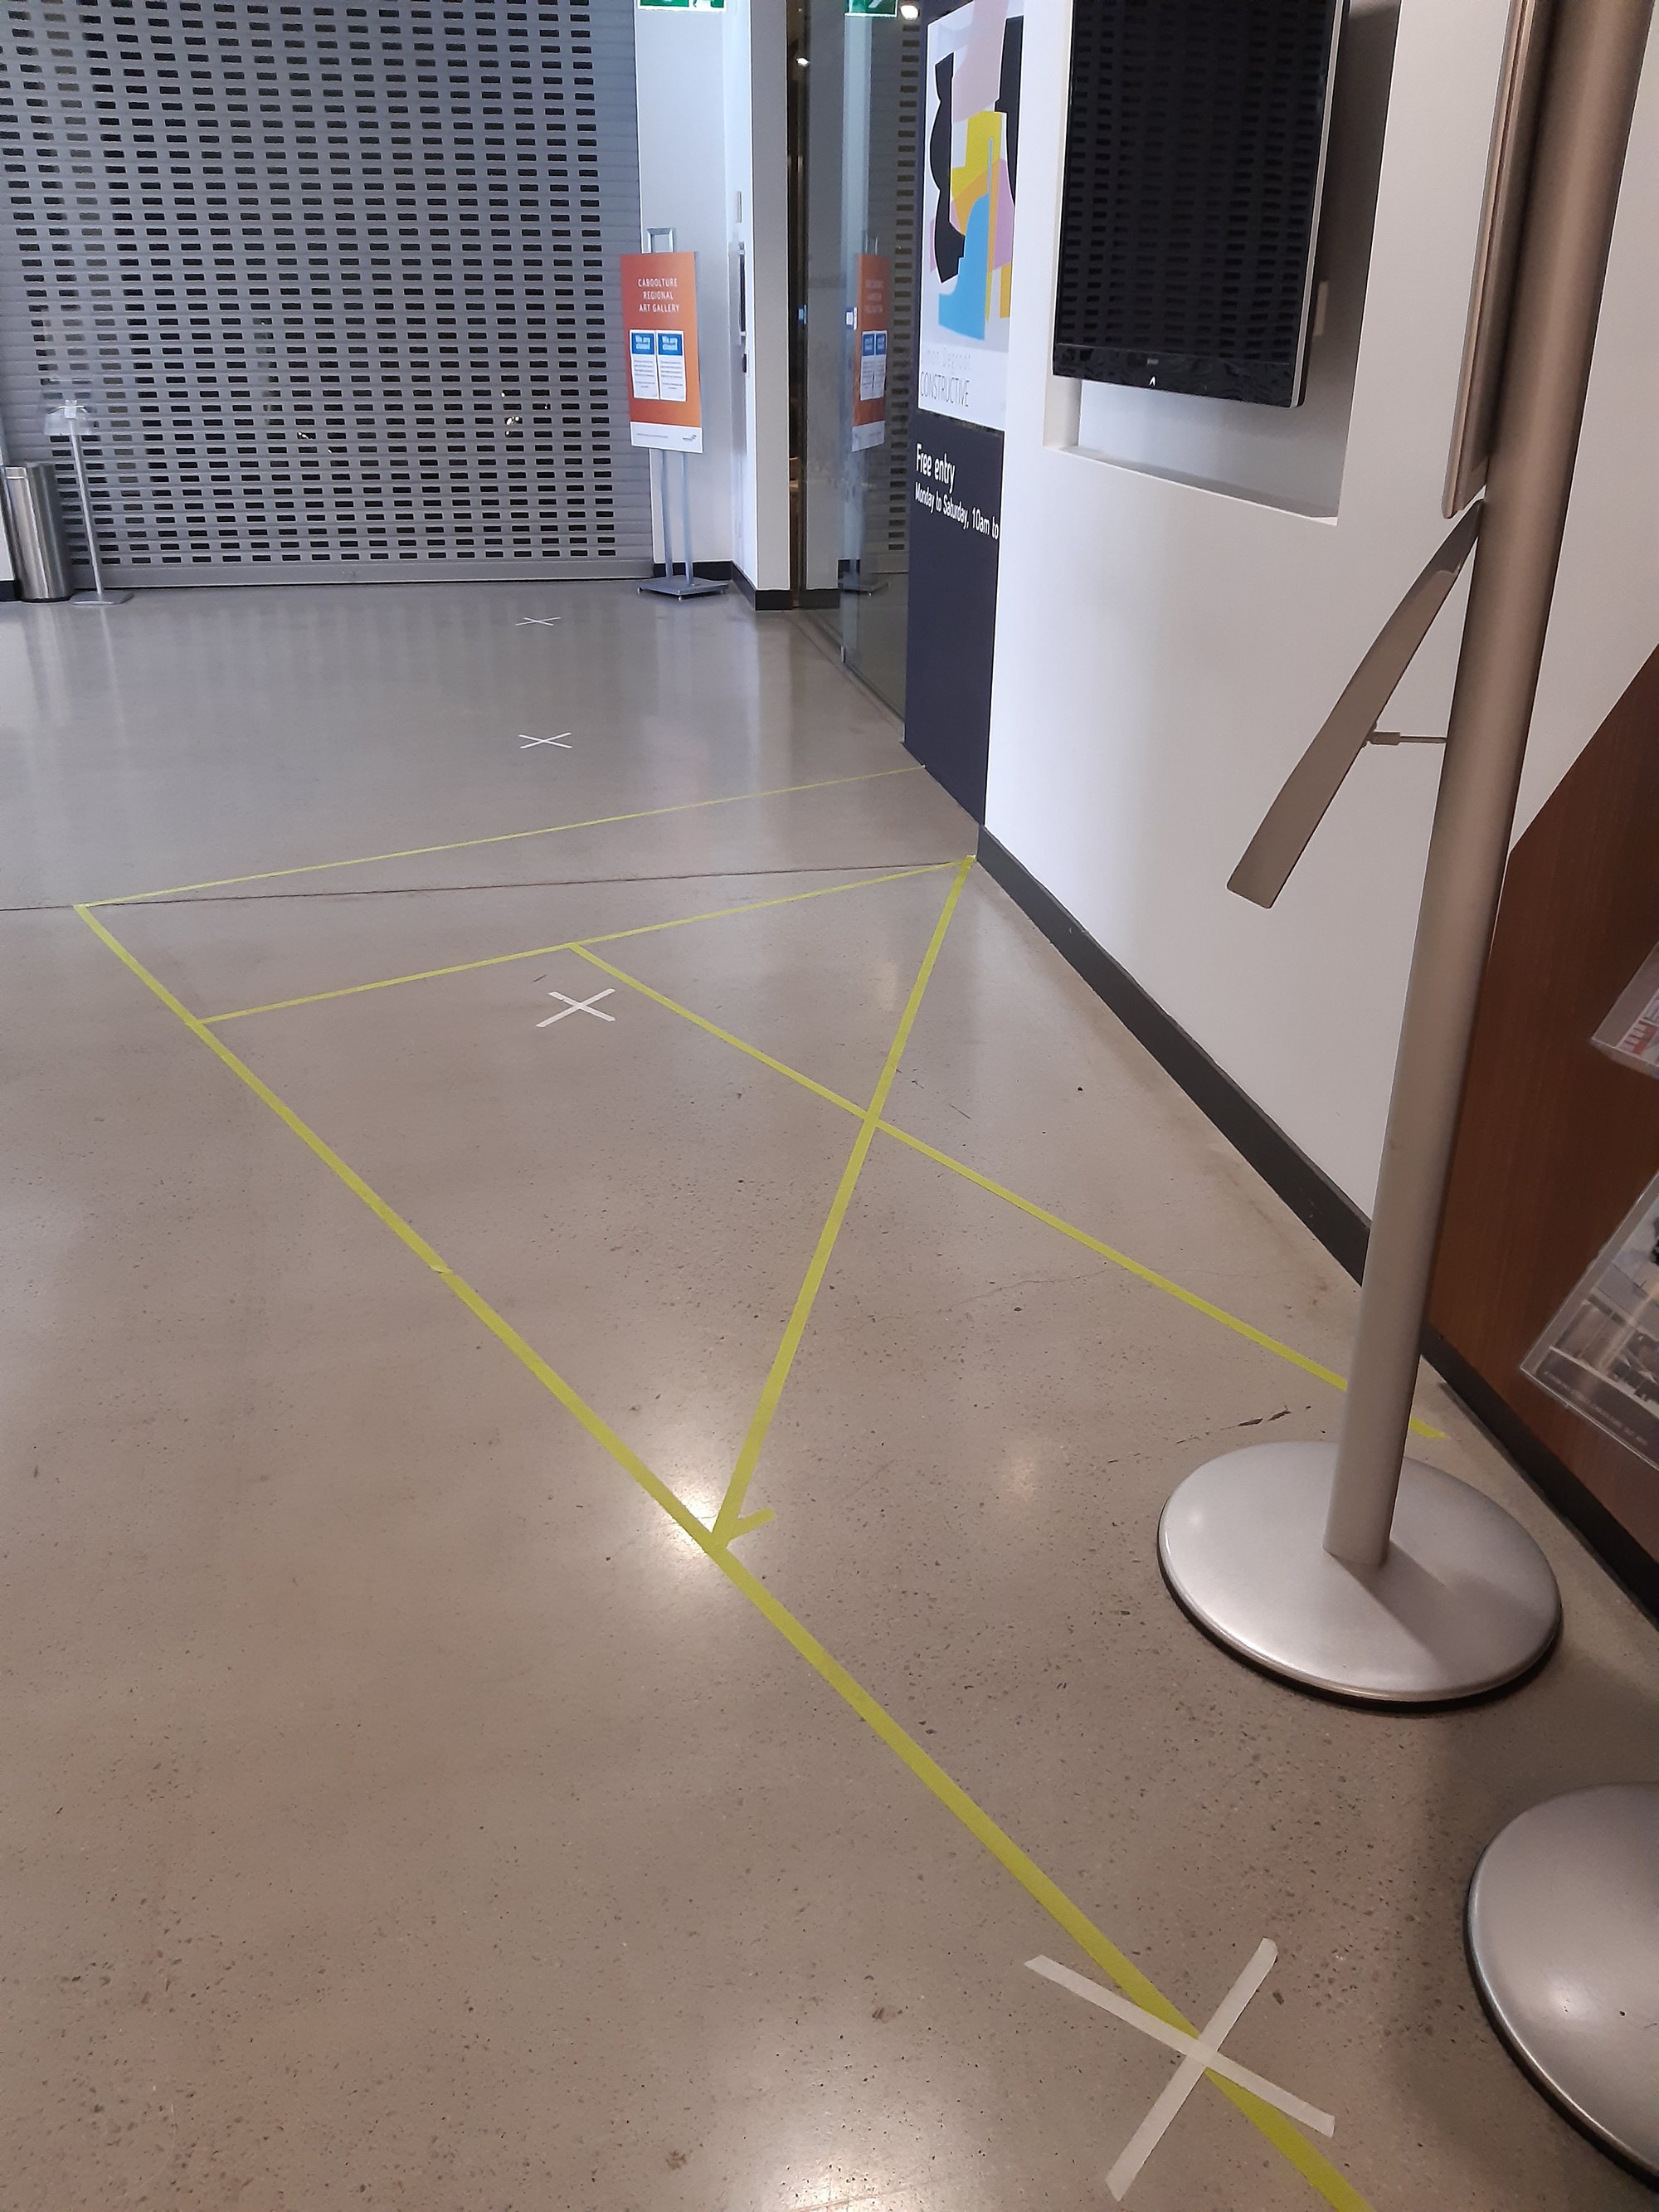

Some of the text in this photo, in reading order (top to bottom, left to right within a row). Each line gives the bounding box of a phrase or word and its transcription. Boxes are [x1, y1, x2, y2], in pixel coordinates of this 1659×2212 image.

[638, 278, 678, 287] CABOOLTURE
[643, 291, 674, 300] REGIONAL
[639, 304, 680, 313] ART GALLERY
[920, 371, 970, 407] CONSTRUCTIVE
[916, 443, 956, 494] Free entry
[915, 481, 1000, 540] Monday to Saturday, 10am to
